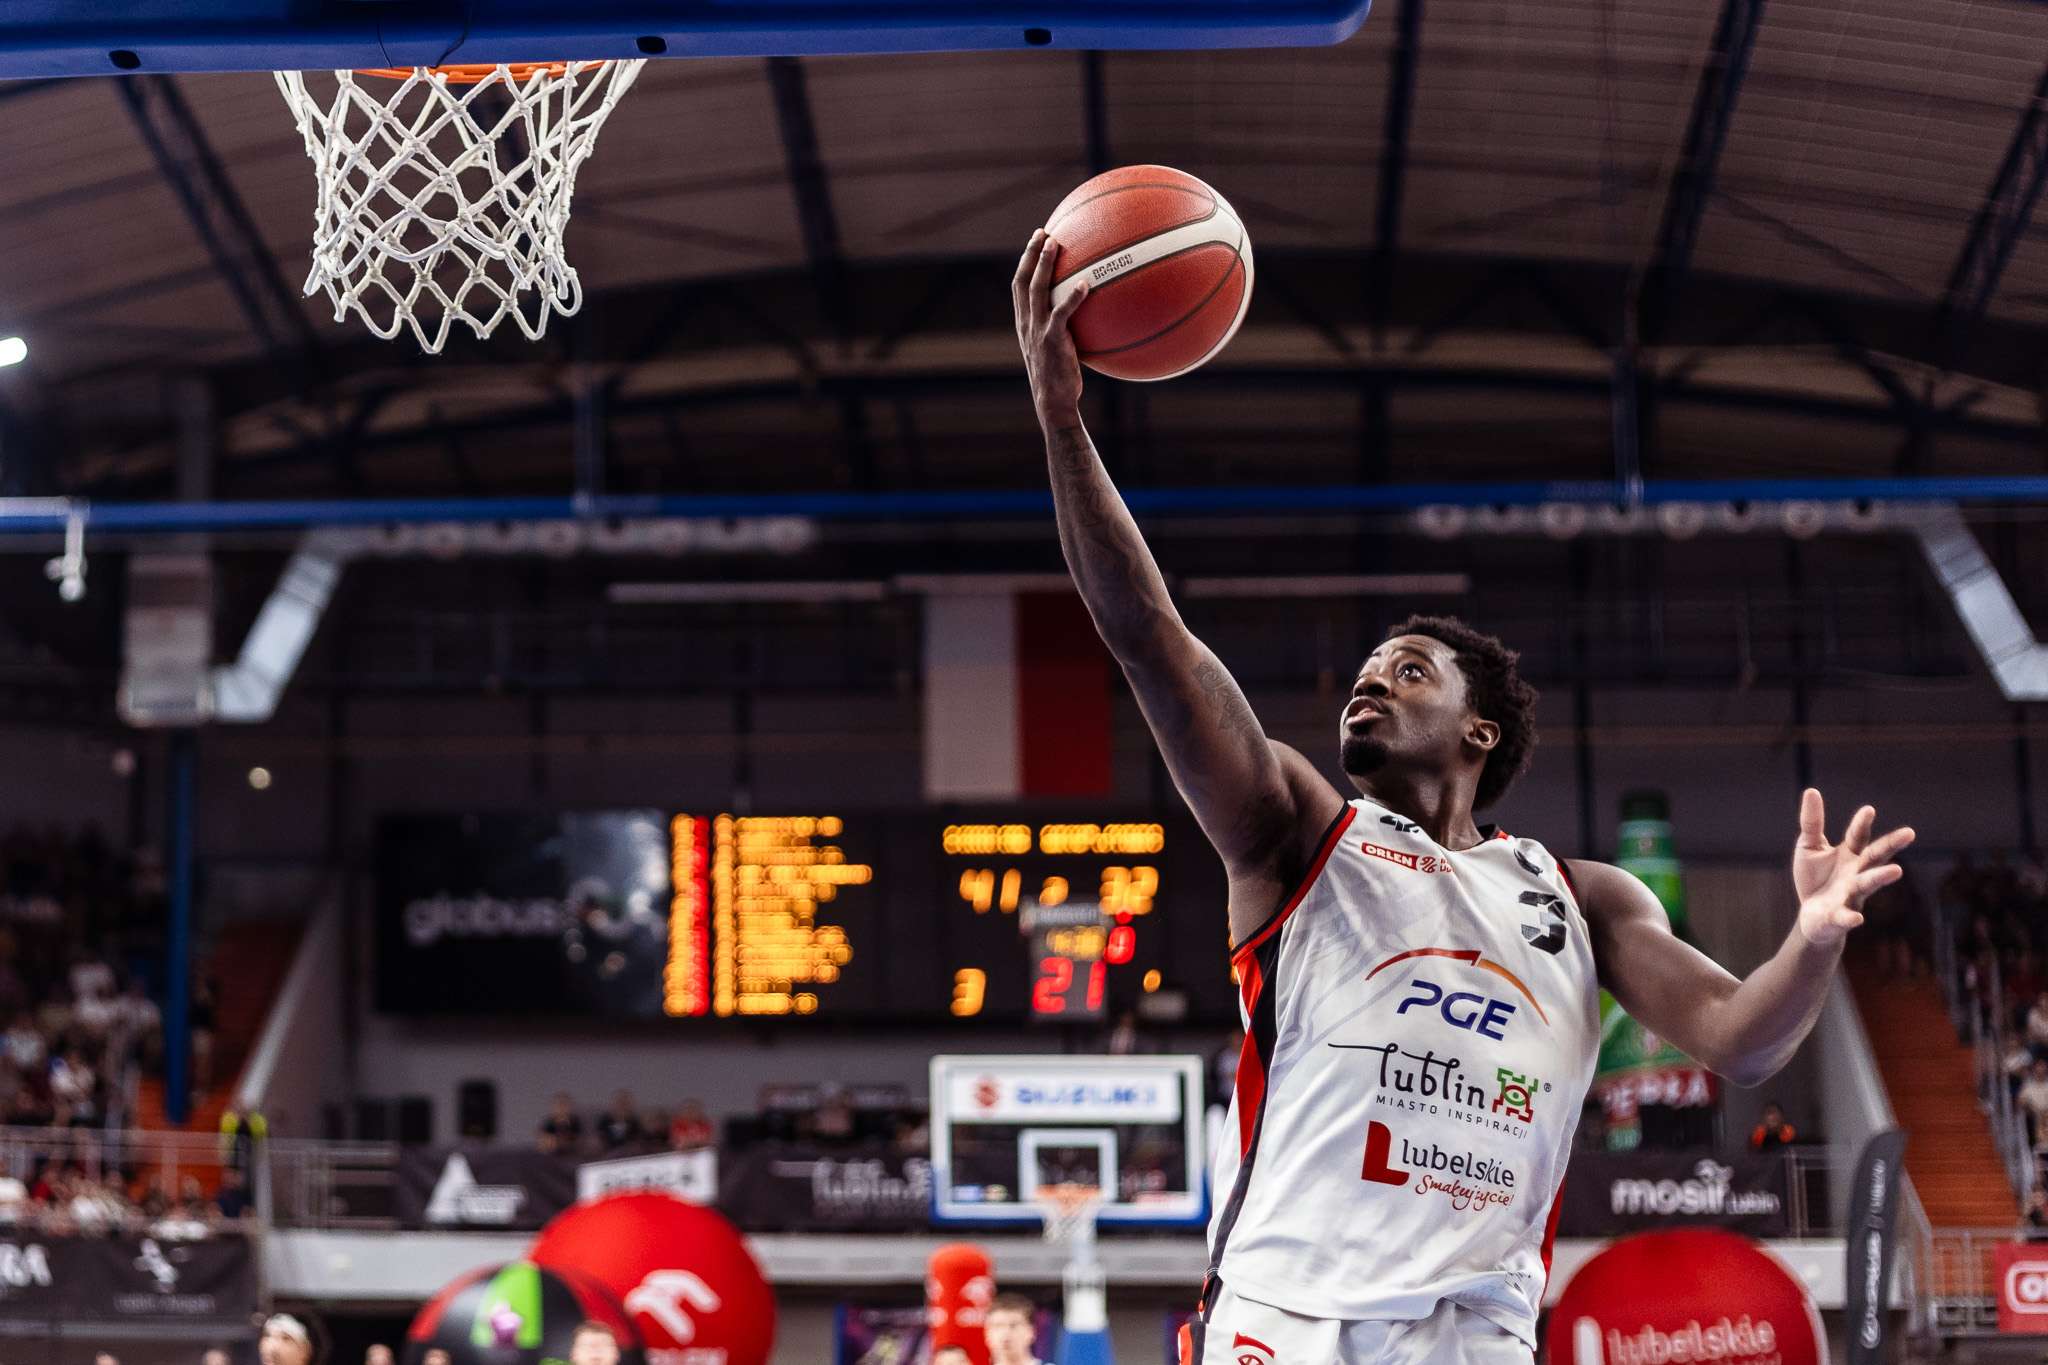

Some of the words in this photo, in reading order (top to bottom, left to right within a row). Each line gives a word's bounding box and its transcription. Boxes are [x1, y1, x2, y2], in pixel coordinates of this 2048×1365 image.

[1365, 845, 1414, 867] ORLEN
[1519, 891, 1567, 955] 3
[1032, 957, 1107, 1014] 21
[1397, 980, 1517, 1041] PGE
[1376, 1094, 1437, 1115] MIASTO
[1448, 1108, 1528, 1139] INSPIRACJI
